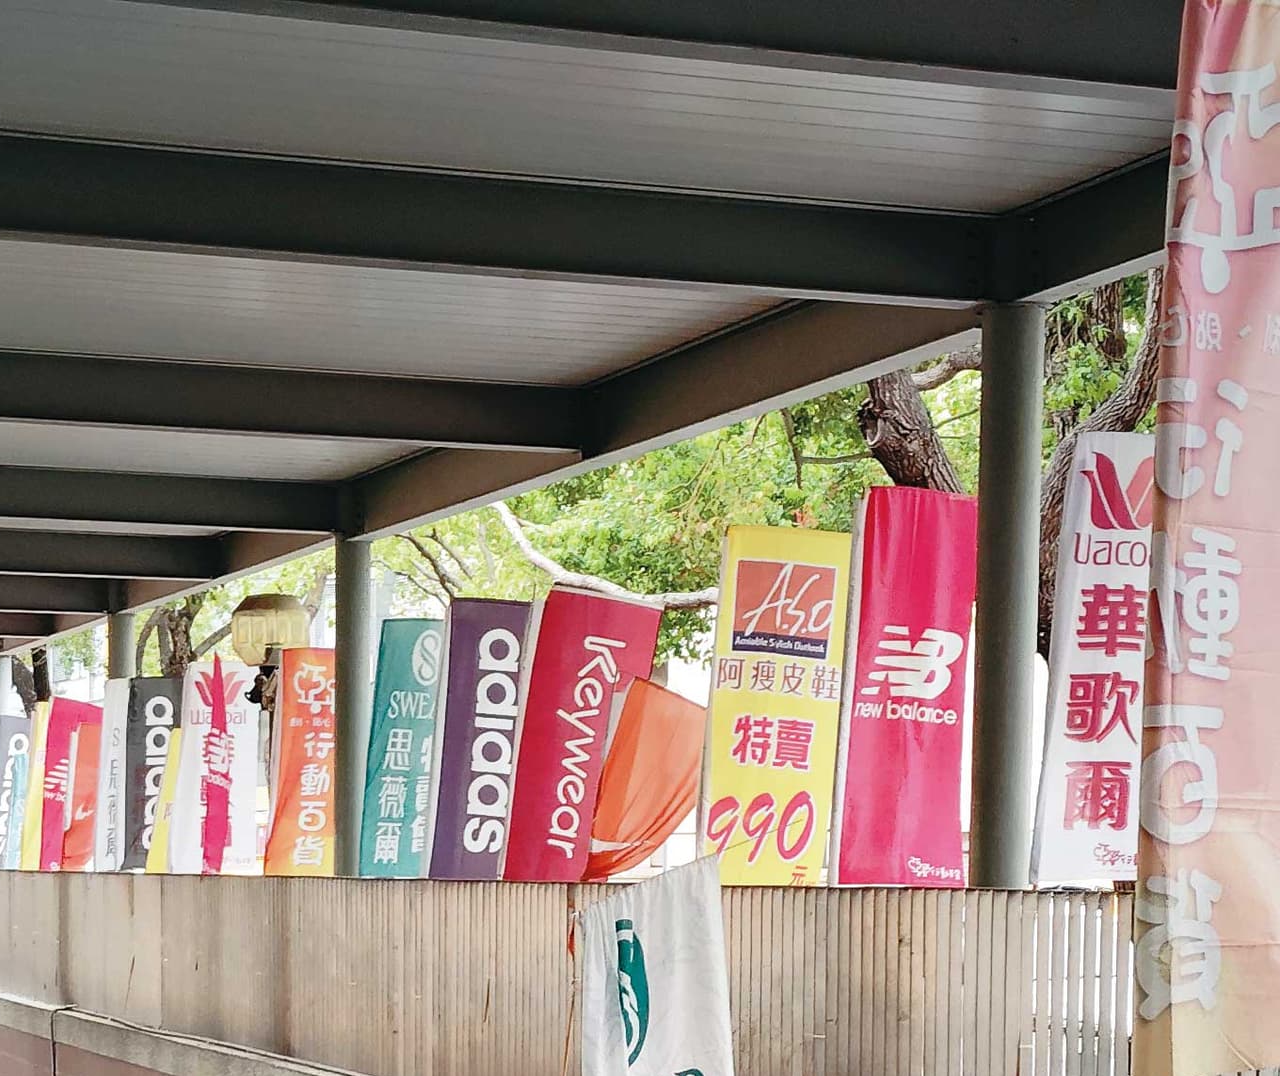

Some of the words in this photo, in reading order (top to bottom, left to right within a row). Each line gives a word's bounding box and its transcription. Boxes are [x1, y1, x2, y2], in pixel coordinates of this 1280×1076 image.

[717, 658, 841, 699] 阿瘦皮鞋
[854, 702, 884, 719] new
[886, 699, 959, 726] balance
[1063, 583, 1146, 831] 華歌爾
[547, 635, 627, 859] Keywear
[732, 715, 816, 771] 特賣
[292, 731, 336, 866] 行動百貨
[373, 728, 413, 864] 思薇爾
[707, 790, 814, 863] 990
